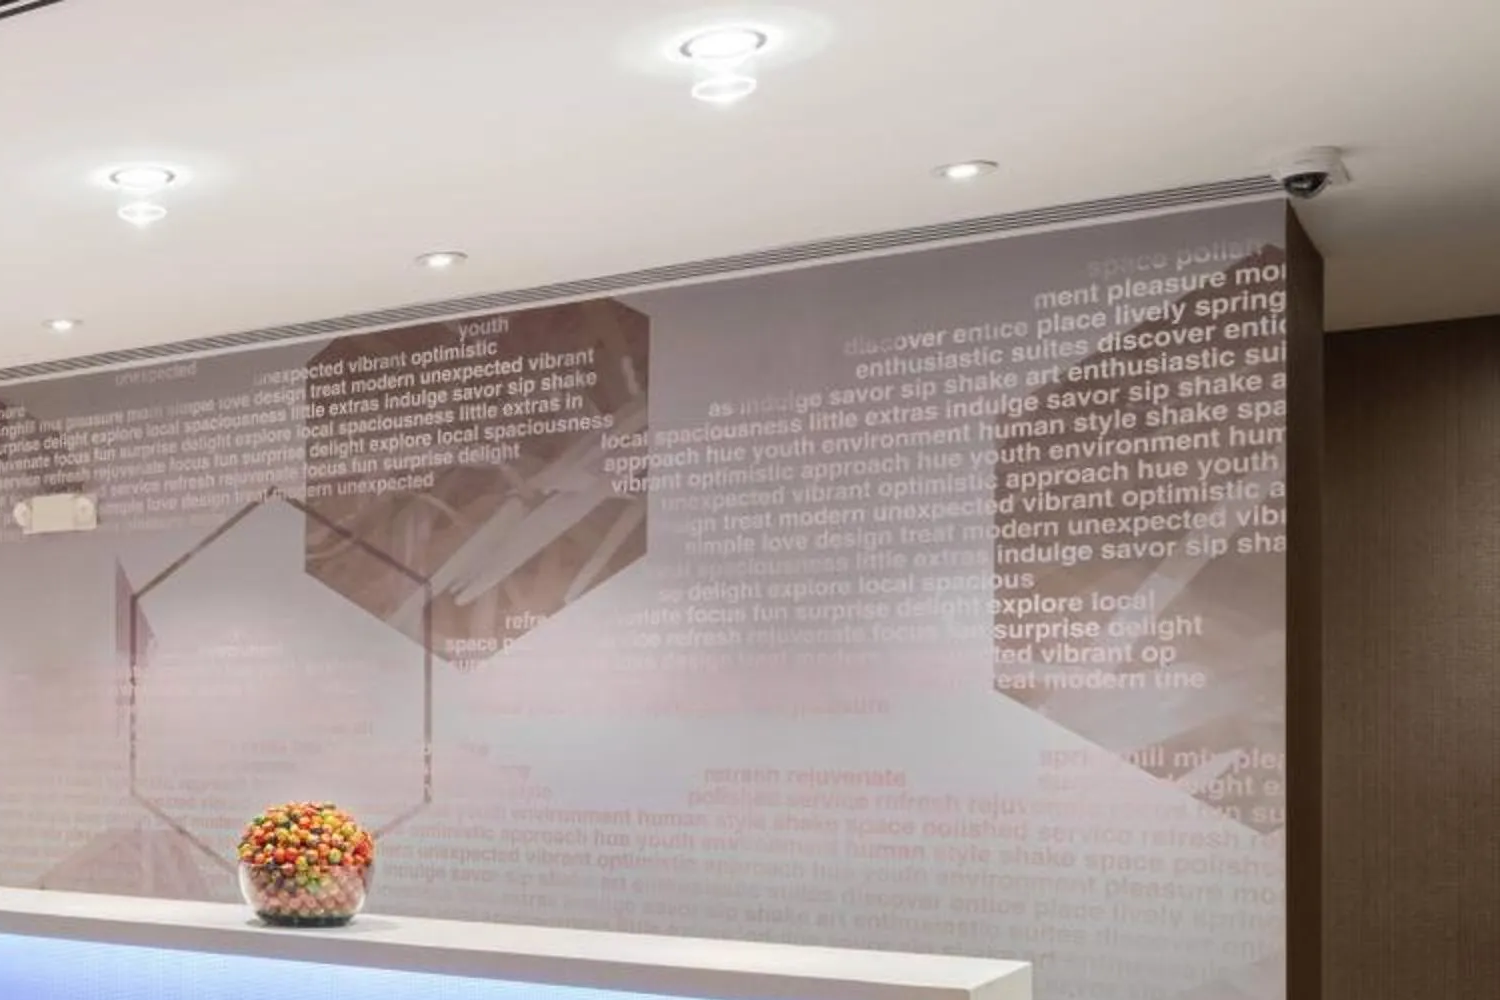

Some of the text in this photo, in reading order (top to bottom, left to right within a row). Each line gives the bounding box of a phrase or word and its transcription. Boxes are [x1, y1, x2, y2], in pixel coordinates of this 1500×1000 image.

[1035, 284, 1098, 308] ment
[1108, 270, 1225, 304] pleasure
[458, 315, 508, 341] youth
[953, 290, 1286, 343] entice place lively spring
[348, 352, 405, 373] vibrant
[411, 340, 497, 367] optimistic
[856, 346, 1002, 378] enthusiastic
[1011, 339, 1087, 362] suites
[1097, 325, 1215, 353] discover
[254, 385, 304, 404] design
[310, 379, 346, 397] treat
[351, 372, 414, 392] modern
[420, 356, 522, 383] unexpected
[528, 348, 594, 370] vibrant
[709, 342, 1286, 417] as savor sip shake art enthusiastic sui
[43, 430, 87, 448] delight
[91, 426, 142, 444] explore
[146, 419, 179, 436] local
[183, 408, 286, 434] spaciousness
[291, 401, 324, 419] little
[329, 397, 378, 415] extras
[385, 388, 447, 408] indulge
[452, 383, 502, 401] savor
[507, 377, 534, 396] sip
[540, 370, 597, 391] shake
[53, 450, 89, 465] focus
[93, 446, 114, 460] fun
[181, 432, 230, 451] delight
[297, 420, 333, 438] local
[338, 409, 453, 436] spaciousness
[459, 402, 496, 421] little
[502, 397, 559, 416] extras
[566, 393, 582, 409] in
[601, 429, 647, 449] local
[653, 418, 802, 447] spaciousness
[809, 410, 856, 431] little
[865, 405, 937, 426] extras
[946, 394, 1038, 418] indulge
[1046, 388, 1120, 409] savor
[1129, 381, 1167, 404] sip
[1177, 372, 1262, 398] shake
[169, 456, 209, 471] focus
[214, 452, 237, 467] fun
[309, 438, 363, 457] delight
[370, 432, 431, 453] explore
[437, 425, 478, 444] local
[484, 414, 613, 442] spaciousness
[604, 399, 1286, 474] approach hue youth environment human style shake spa
[304, 461, 346, 477] focus
[352, 457, 377, 473] fun
[382, 450, 452, 471] surprise
[458, 443, 519, 464] delight
[611, 472, 680, 493] vibrant
[687, 463, 792, 490] optimistic
[800, 453, 907, 482] approach
[916, 451, 962, 470] hue
[970, 442, 1040, 470] youth
[1049, 429, 1219, 460] environment
[661, 450, 1278, 512] unexpected vibrant optimistic approach hue youth
[337, 470, 434, 494] unexpected
[724, 512, 772, 530] treat
[779, 507, 864, 527] modern
[874, 495, 1013, 522] unexpected
[1023, 489, 1113, 512] vibrant
[1123, 479, 1259, 510] optimistic
[763, 532, 806, 550] love
[815, 527, 891, 549] design
[900, 524, 952, 543] treat
[962, 519, 1058, 540] modern
[1068, 507, 1226, 536] unexpected
[997, 542, 1091, 565] indulge
[1101, 540, 1175, 559] savor
[1185, 534, 1227, 558] sip
[687, 580, 762, 602] delight
[859, 573, 914, 593] local
[922, 570, 1034, 595] spacious
[753, 603, 787, 621] fun
[991, 594, 1082, 617] explore
[1091, 590, 1154, 610] local
[445, 637, 497, 655] space
[994, 615, 1203, 642] surprise delight
[1041, 644, 1131, 663] vibrant
[1141, 645, 1175, 665] op
[1044, 669, 1144, 688] modern
